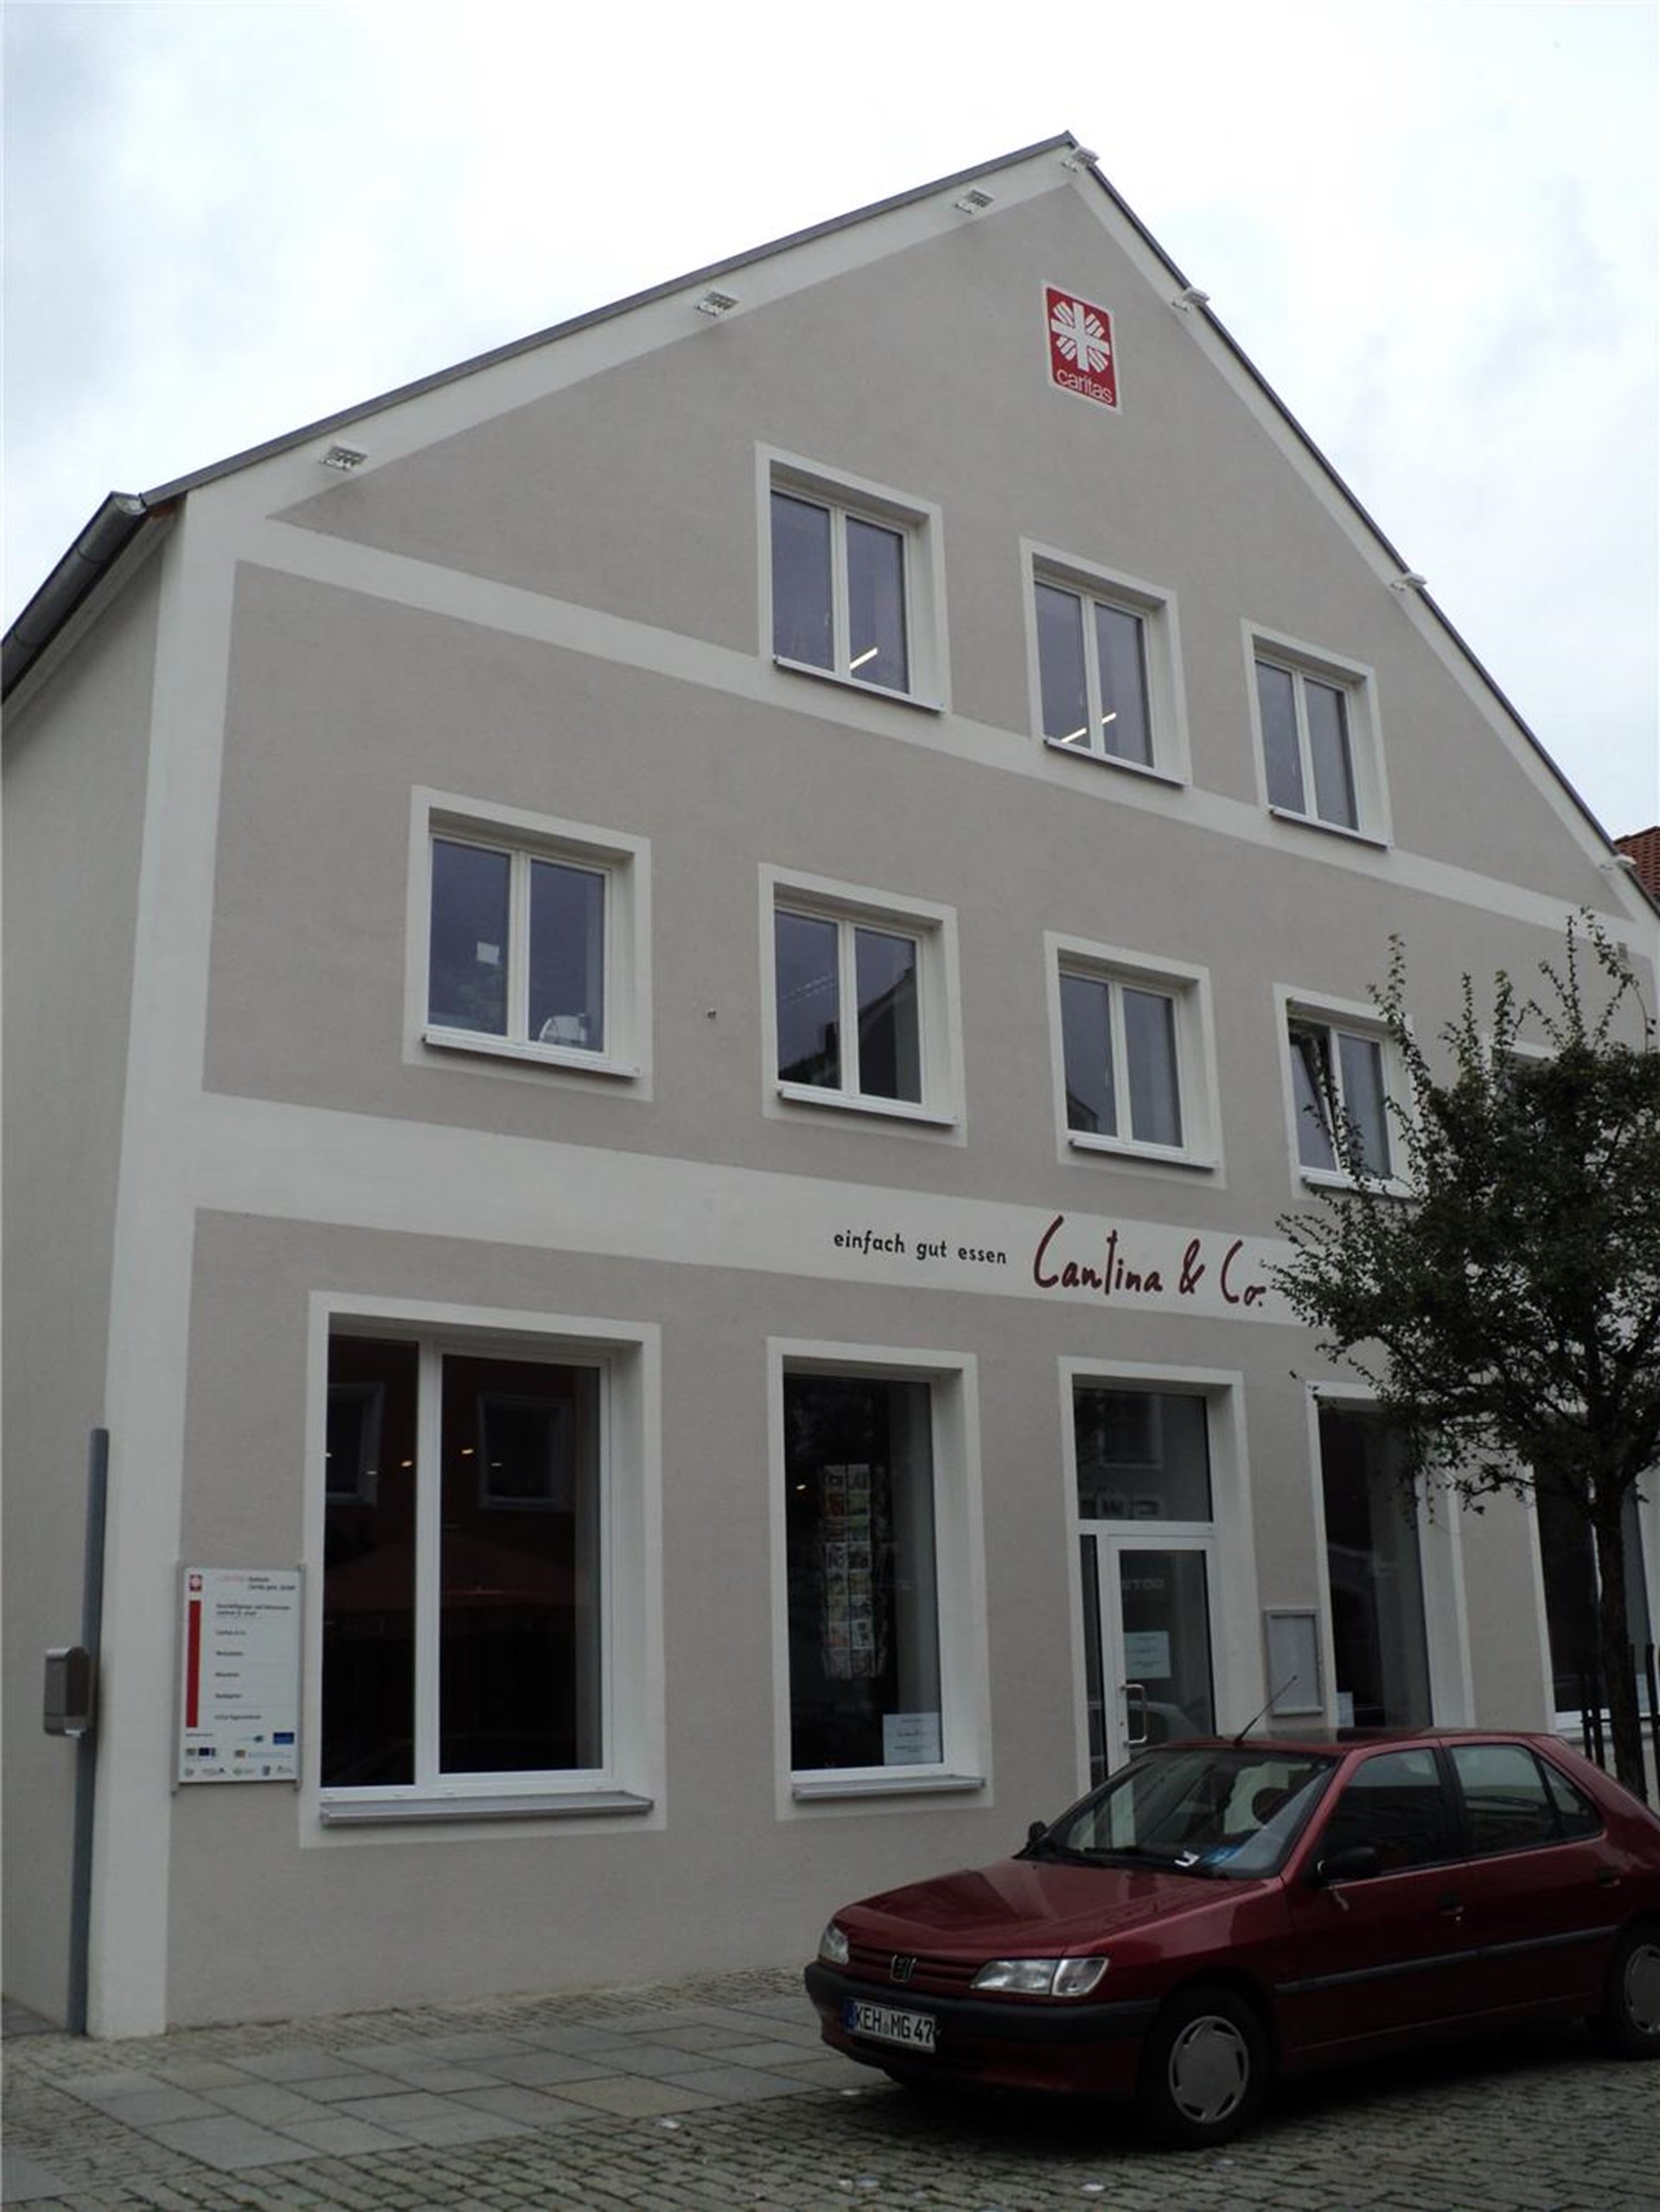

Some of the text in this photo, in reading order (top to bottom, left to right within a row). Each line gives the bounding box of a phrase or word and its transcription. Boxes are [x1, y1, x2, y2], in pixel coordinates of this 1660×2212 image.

[1057, 369, 1113, 403] caritas
[833, 1229, 1007, 1265] einfach gut essen
[1033, 1214, 1164, 1297] Cantina
[1178, 1238, 1206, 1295] &
[914, 2018, 934, 2044] 47
